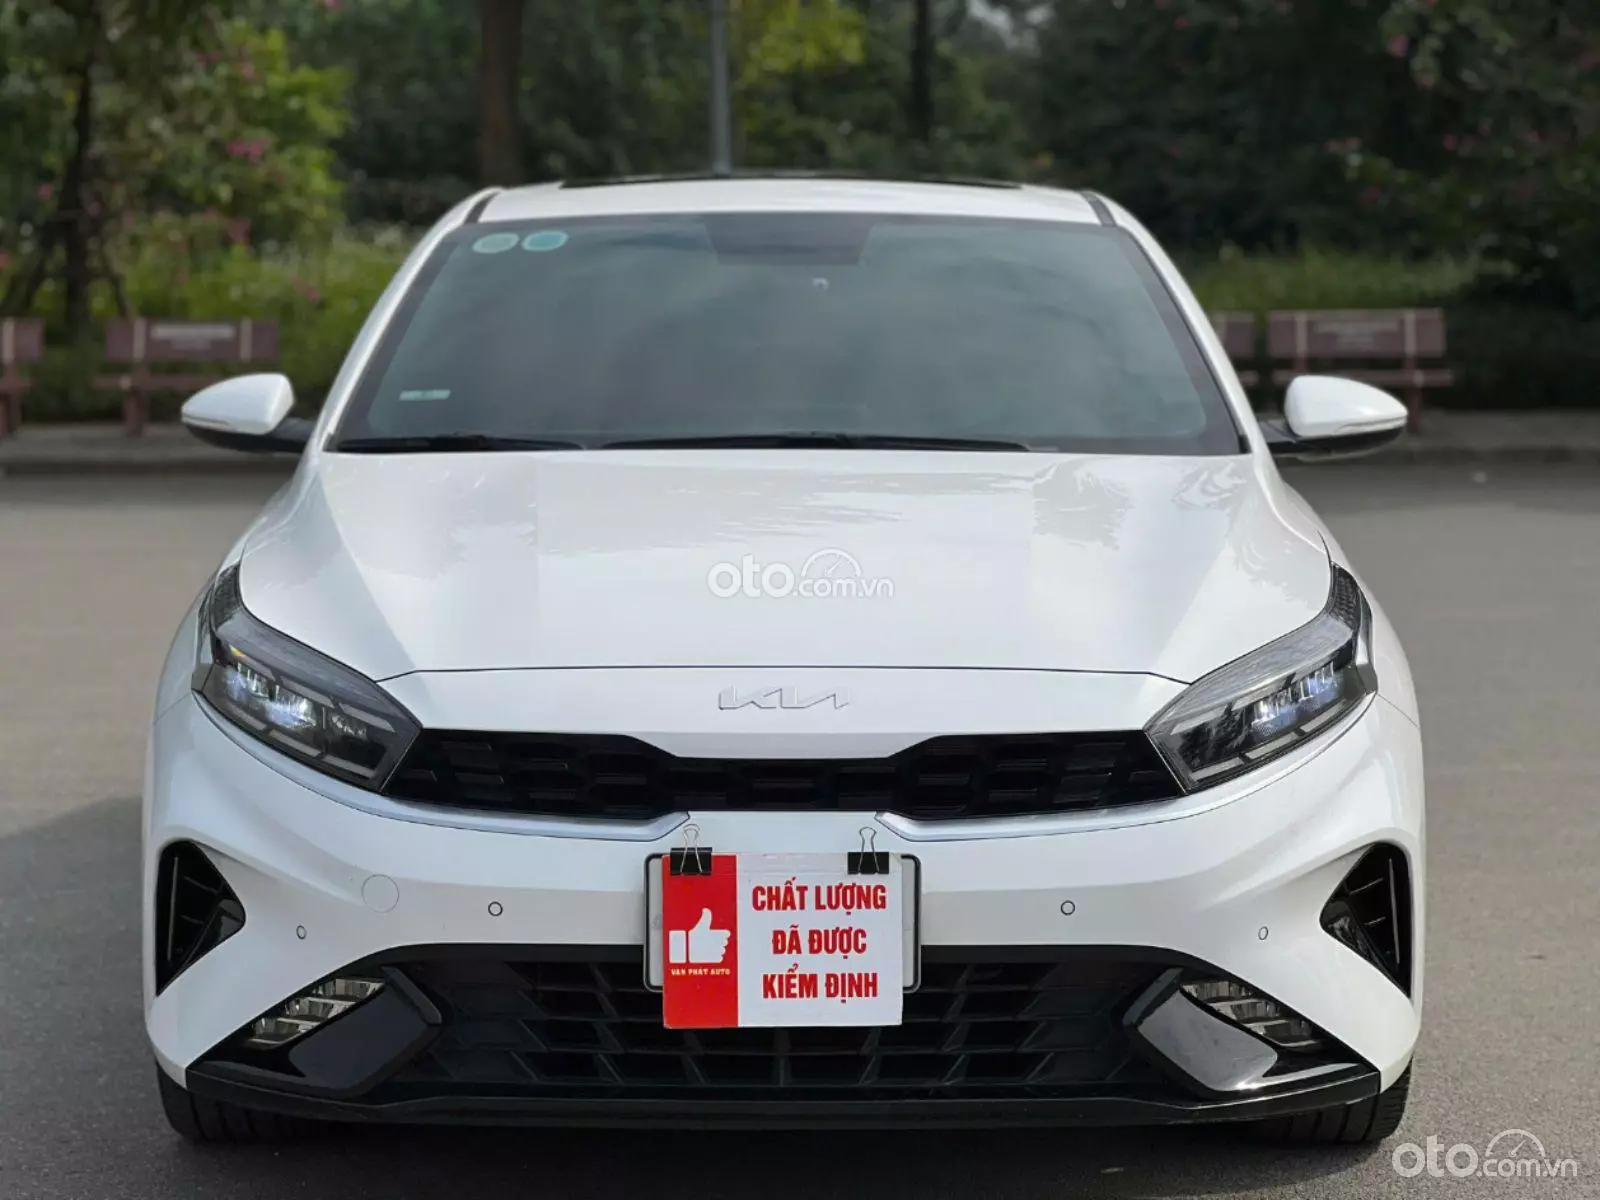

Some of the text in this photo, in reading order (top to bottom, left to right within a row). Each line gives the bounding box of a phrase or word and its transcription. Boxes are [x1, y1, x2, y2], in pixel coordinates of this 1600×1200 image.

[752, 877, 886, 915] CHẤT LƯỢNG
[772, 924, 867, 959] ĐÃ ĐƯỢC
[711, 968, 730, 976] AUTO
[763, 963, 878, 1003] KIỂM ĐỊNH
